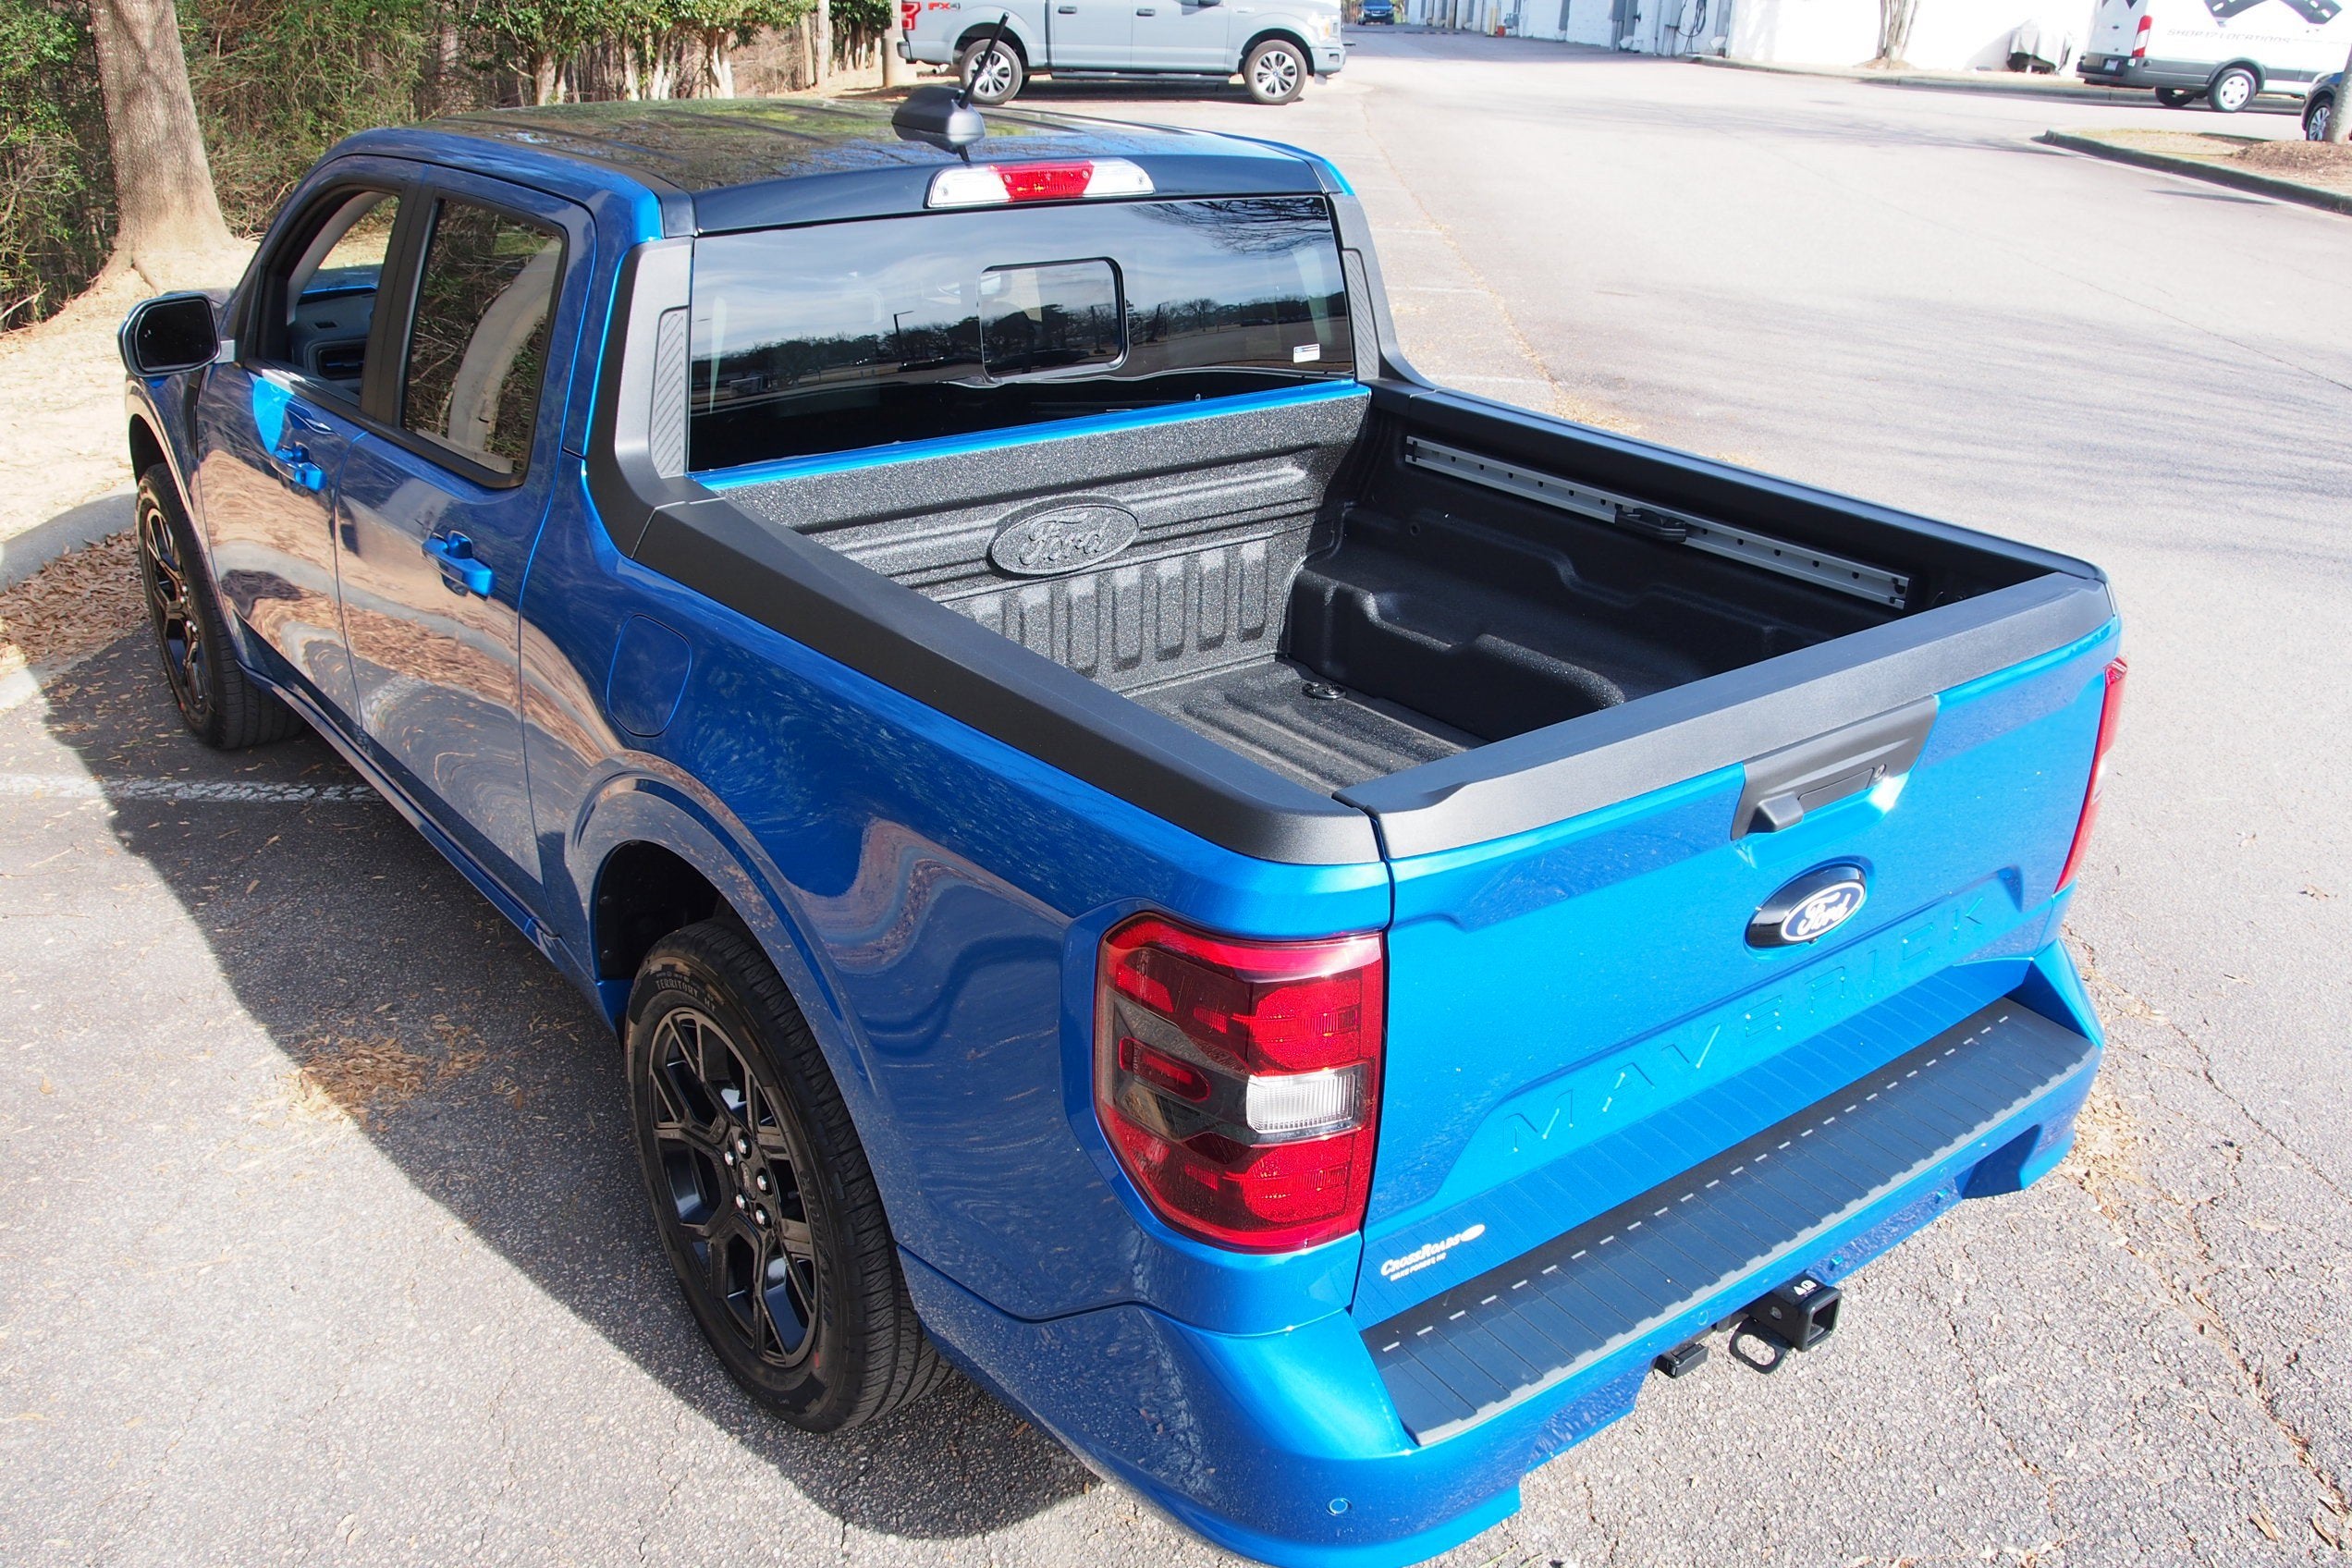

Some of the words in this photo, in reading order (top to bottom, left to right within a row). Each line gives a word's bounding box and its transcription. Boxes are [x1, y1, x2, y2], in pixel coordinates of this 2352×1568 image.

[2166, 28, 2204, 38] SHOP
[1018, 510, 1111, 566] Ford
[1796, 891, 1852, 936] Ford
[655, 978, 699, 999] TERRITORY
[1502, 897, 1985, 1158] MAVERICK
